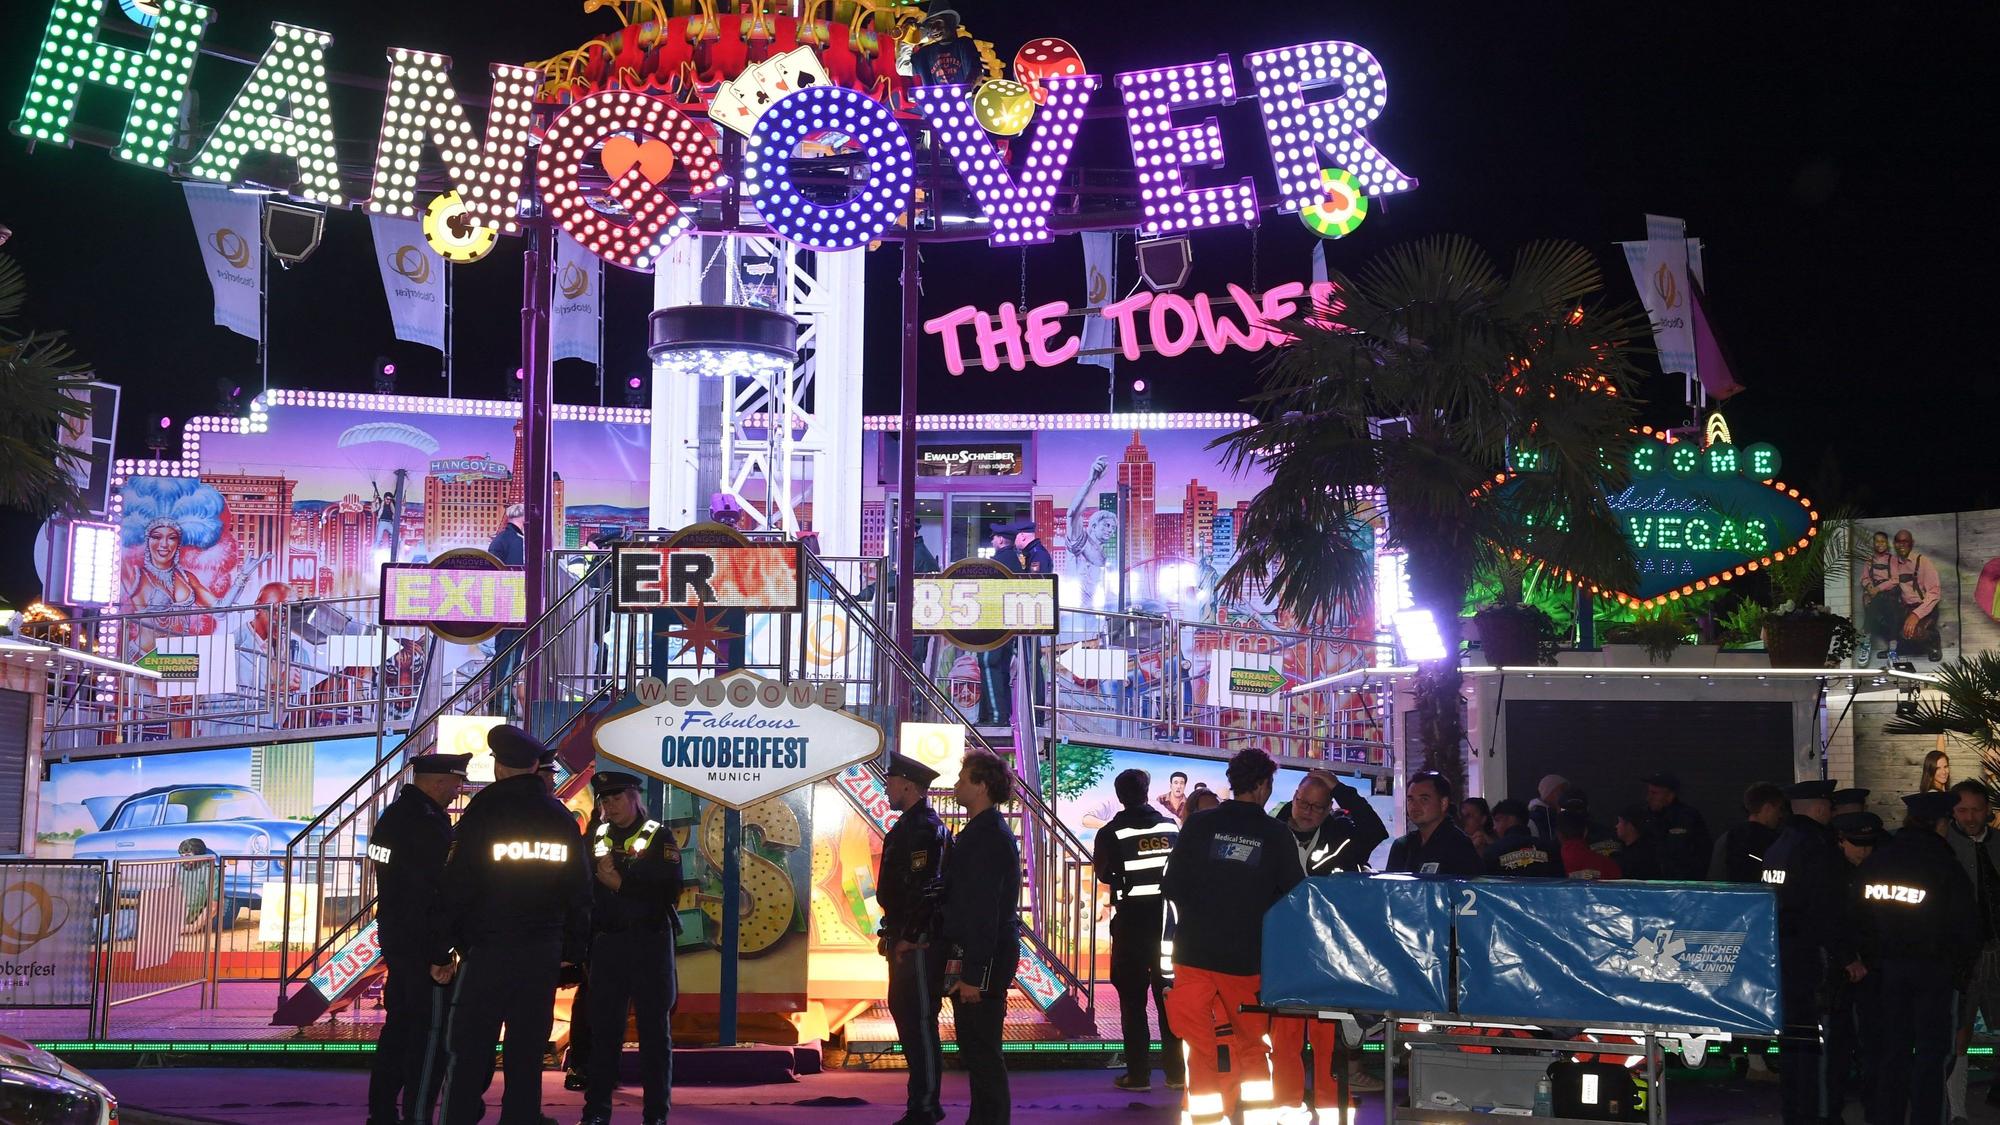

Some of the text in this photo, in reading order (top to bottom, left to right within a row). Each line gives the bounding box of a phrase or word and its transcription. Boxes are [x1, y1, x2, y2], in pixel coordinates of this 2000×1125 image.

[8, 0, 1418, 272] HANGOVER
[924, 300, 1080, 376] THE
[432, 461, 505, 473] HANGOVER
[1629, 516, 1769, 551] VEGAS
[292, 559, 315, 580] NO
[619, 551, 718, 605] ER
[396, 575, 526, 618] EXIT
[912, 582, 981, 626] 85
[144, 657, 199, 665] ENTRANCE
[1231, 671, 1281, 682] ENTRANCE
[1236, 679, 1273, 688] EINGANG
[640, 684, 838, 705] WELCOME
[655, 710, 801, 732] TO Fabulous
[662, 735, 809, 769] OKTOBERFEST
[708, 772, 761, 781] MUNICH
[1139, 837, 1170, 851] GGS
[1215, 833, 1262, 848] Medical Service
[493, 841, 568, 862] POLIZEI
[1460, 889, 1478, 916] 2
[1865, 884, 1926, 904] POLIZEI
[1678, 953, 1739, 963] AMBULANZ
[1699, 945, 1741, 954] AICHER
[1700, 964, 1735, 972] UNION
